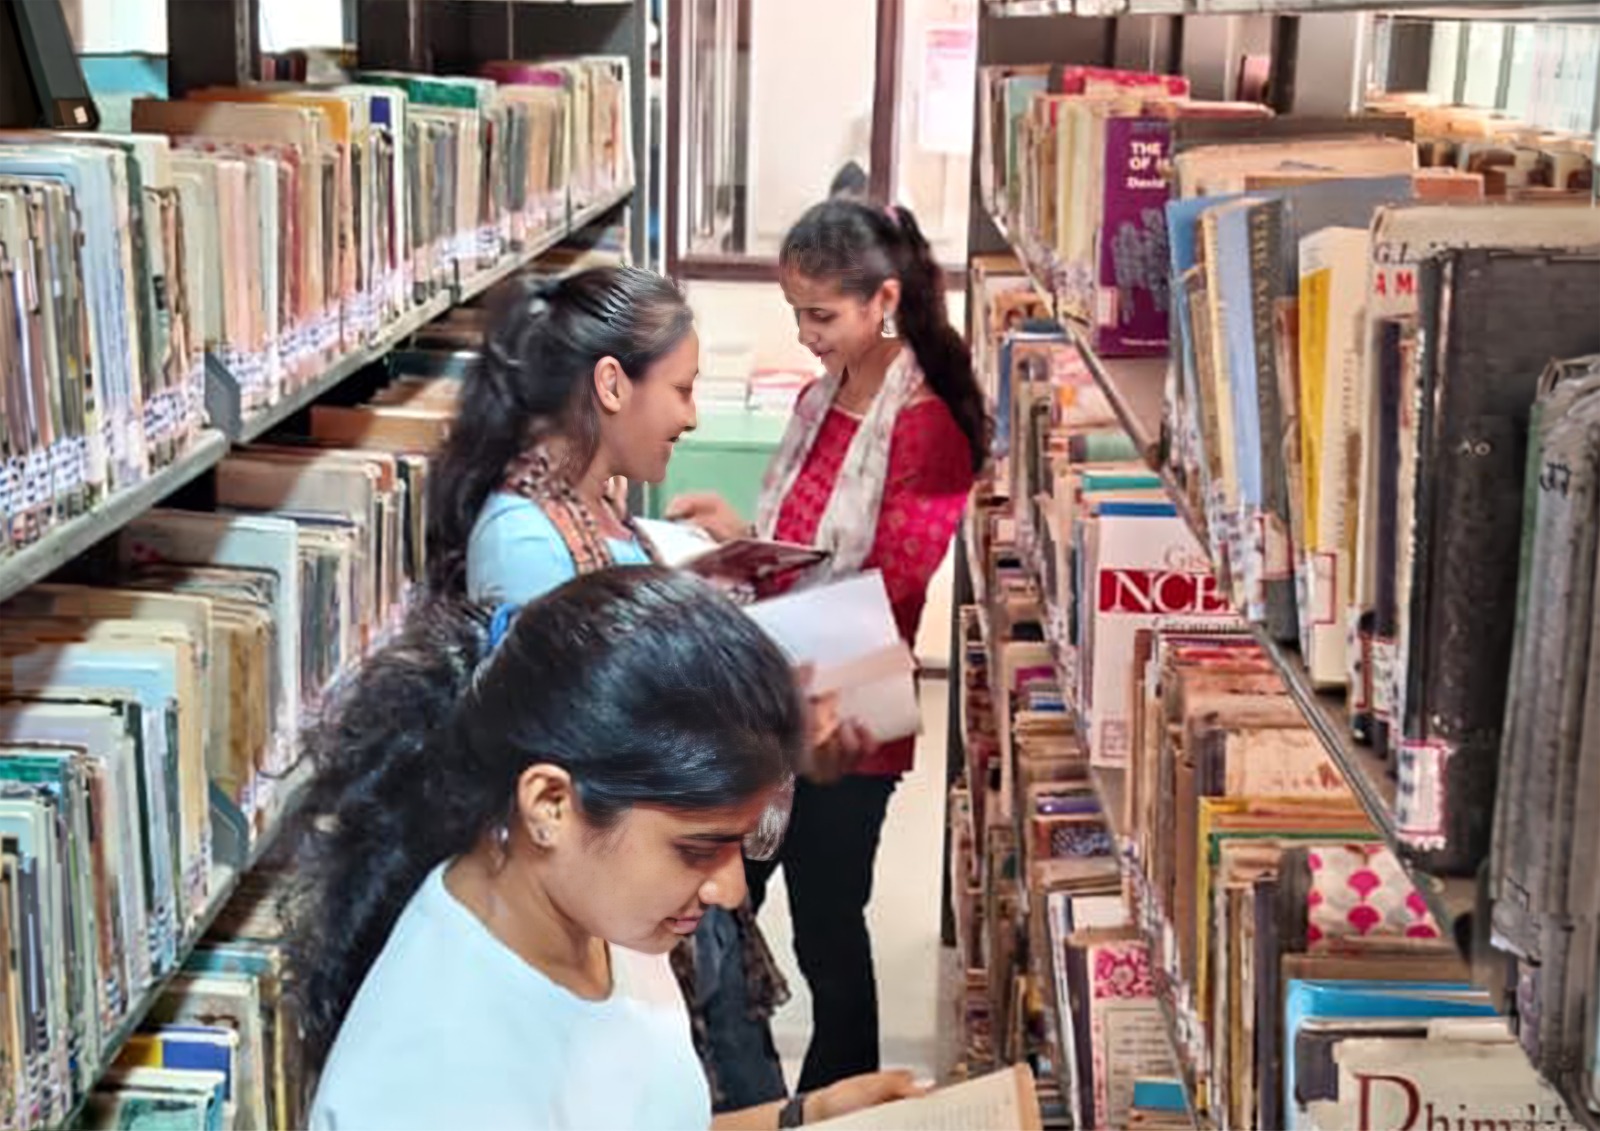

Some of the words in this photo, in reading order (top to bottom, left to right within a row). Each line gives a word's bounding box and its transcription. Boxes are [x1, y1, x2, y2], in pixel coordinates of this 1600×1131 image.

[1131, 141, 1161, 155] THE
[1129, 157, 1150, 170] OF
[1112, 570, 1234, 613] NCE
